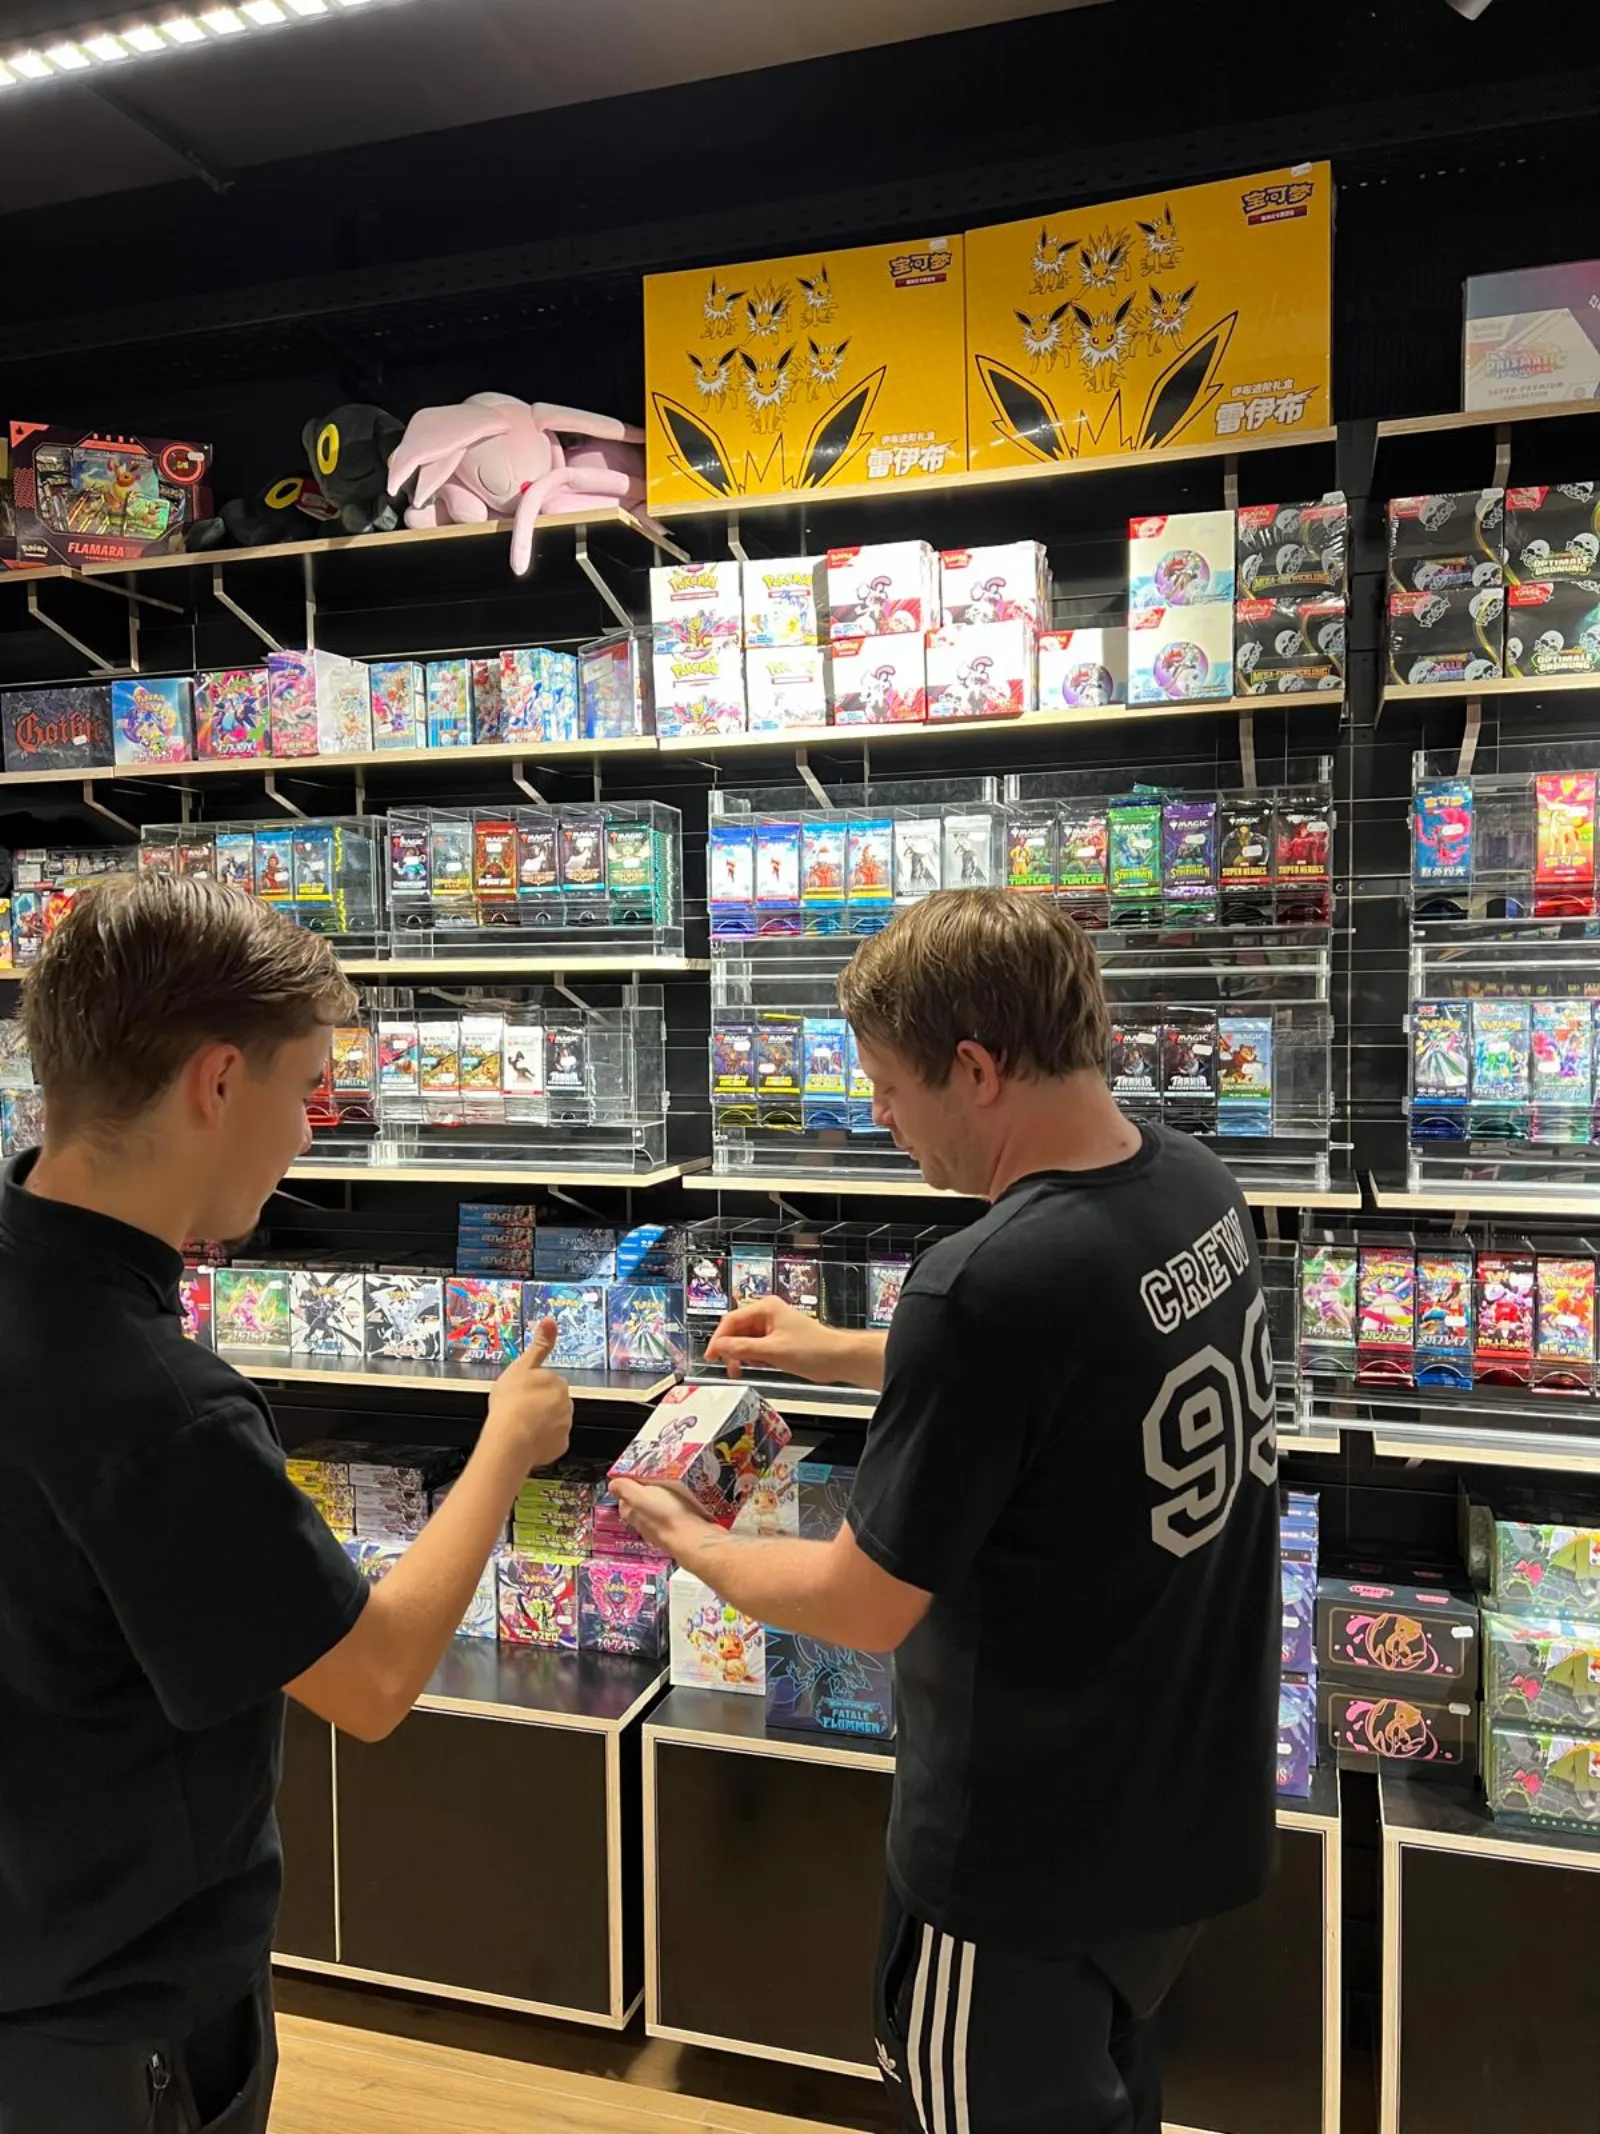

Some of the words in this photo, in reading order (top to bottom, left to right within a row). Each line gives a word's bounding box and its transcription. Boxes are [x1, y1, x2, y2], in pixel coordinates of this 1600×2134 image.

[1241, 182, 1313, 214] 宝可梦
[889, 252, 952, 277] 宝可梦
[1215, 391, 1308, 435] 雷伊布
[867, 441, 952, 480] 雷伊布
[68, 542, 125, 557] FLAMARA
[1532, 557, 1588, 571] OPTIMALE
[1536, 654, 1593, 667] OPTIMALE
[1121, 824, 1152, 832] MAGIC
[1178, 820, 1209, 830] MAGIC
[1020, 828, 1048, 836] MAGIC
[1222, 867, 1241, 876] SUPER
[1242, 867, 1267, 876] HEROES
[1279, 866, 1299, 875] SUPER
[1300, 865, 1324, 874] HEROES
[1009, 875, 1050, 885] TURTLES
[1062, 875, 1104, 885] TURTLES
[1140, 1206, 1249, 1335] CREW
[1142, 1288, 1277, 1558] 99
[831, 1708, 870, 1720] FATALE
[822, 1716, 881, 1734] FLAMMEN
